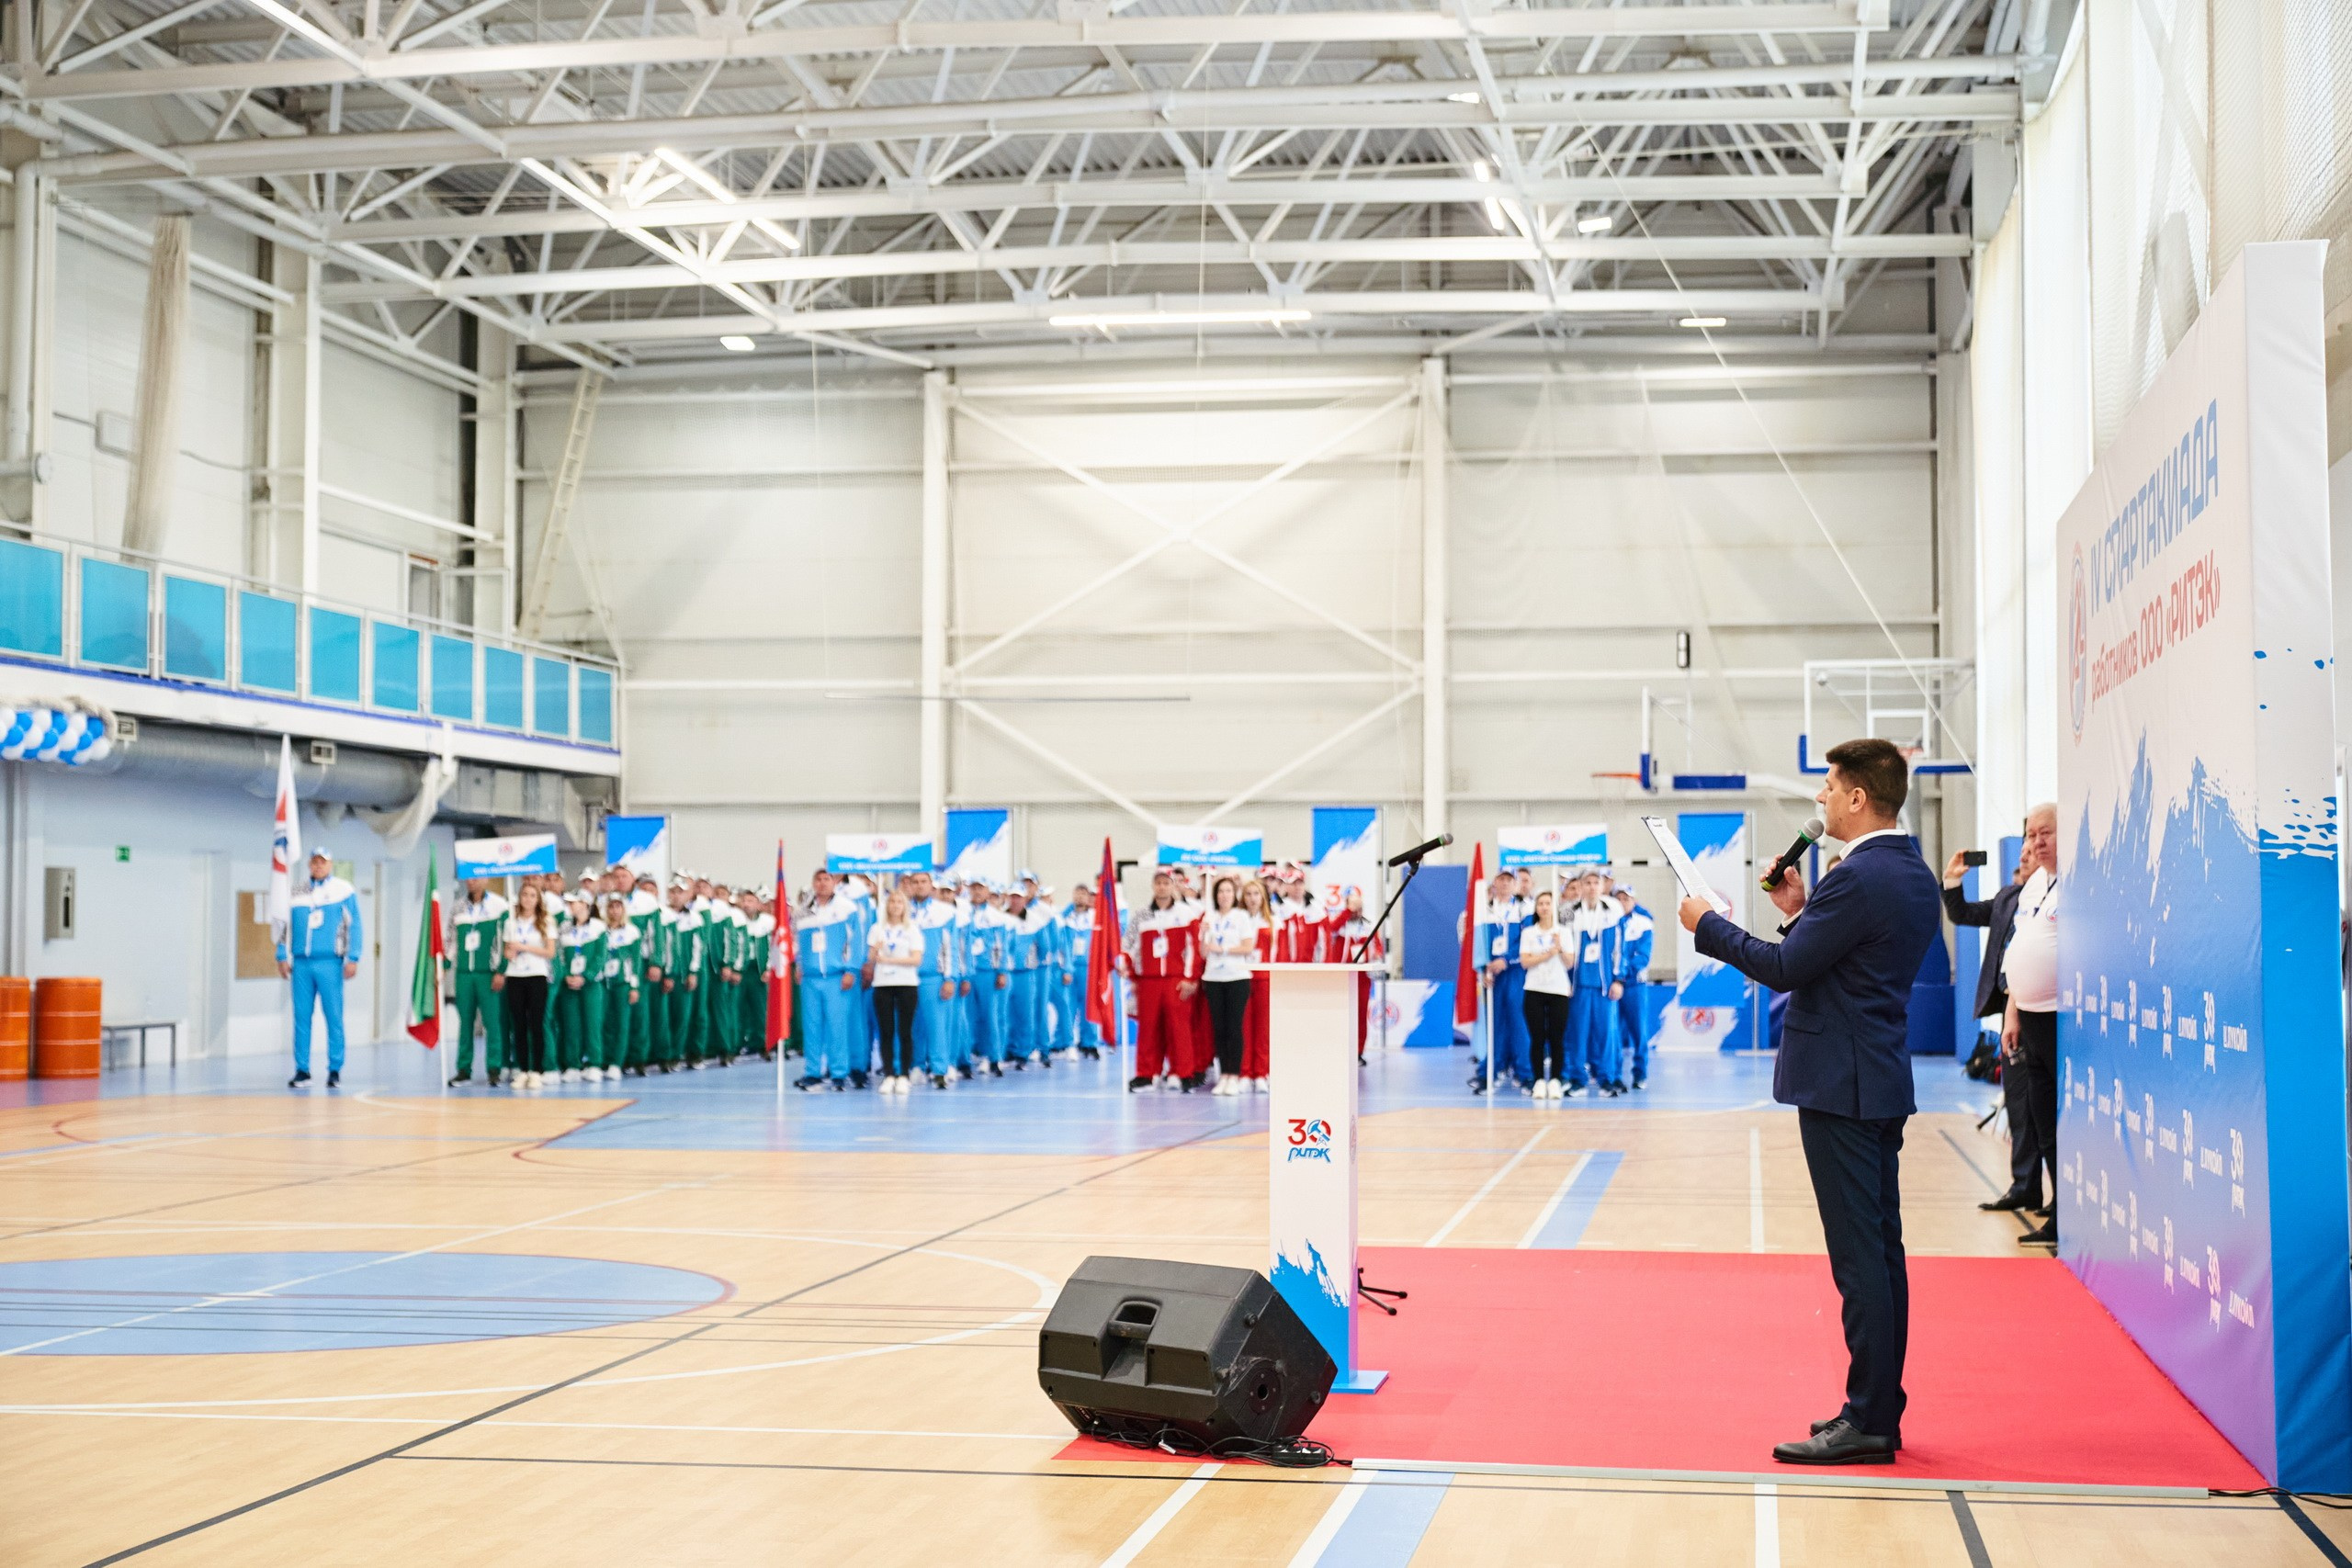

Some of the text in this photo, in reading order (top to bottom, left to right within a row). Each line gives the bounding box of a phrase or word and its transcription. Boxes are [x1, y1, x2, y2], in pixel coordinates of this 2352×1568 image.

[2091, 398, 2219, 618] IV СПАРТАКИАДА
[2092, 548, 2221, 714] работников ООО «РИТЭК»
[1288, 1119, 1331, 1146] 30
